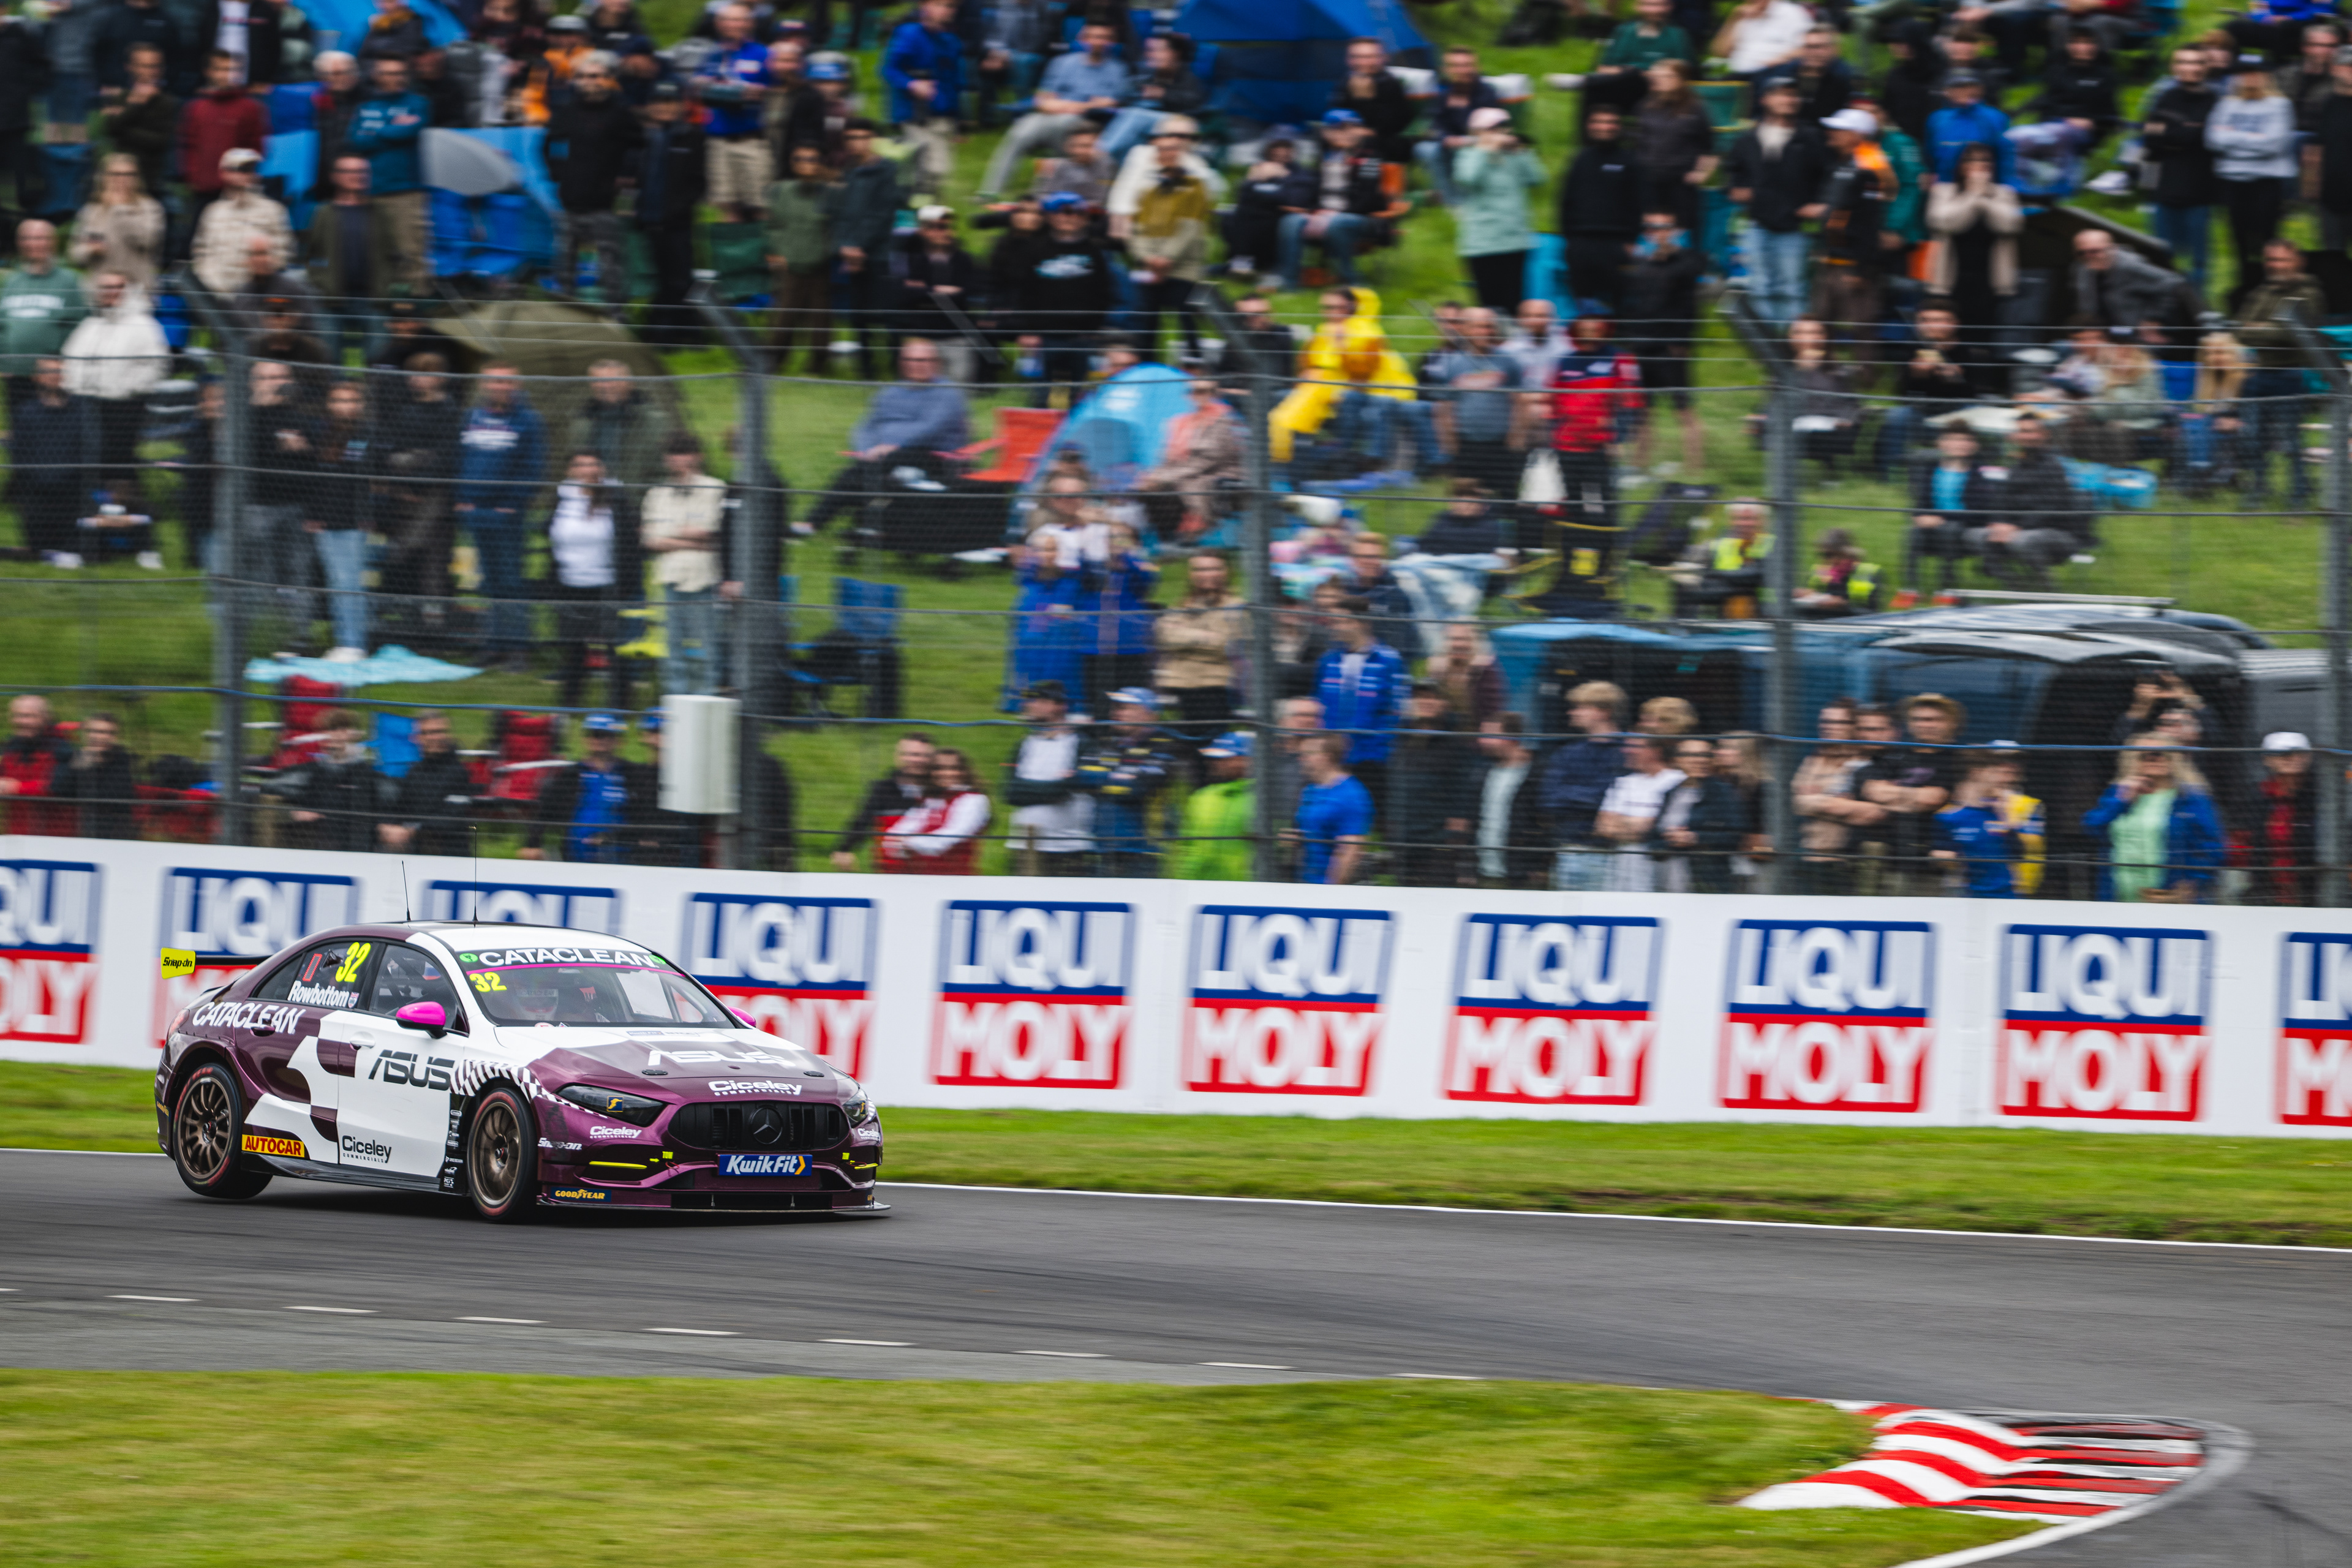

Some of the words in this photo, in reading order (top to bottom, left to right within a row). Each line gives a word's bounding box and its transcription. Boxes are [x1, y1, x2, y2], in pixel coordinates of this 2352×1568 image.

[335, 942, 371, 982] 32
[478, 948, 657, 968] CATACLEAN
[287, 980, 350, 1008] Rowbottom
[469, 972, 507, 992] 32
[192, 1001, 306, 1034] CATACLEAN
[940, 1000, 1131, 1081] MOLY
[1188, 1006, 1384, 1088] MOLY
[368, 1049, 455, 1091] ASUS
[648, 1050, 796, 1067] ASUS
[1453, 1015, 1655, 1098] MOLY
[1726, 1021, 1933, 1104] MOLY
[2003, 1029, 2210, 1112] MOLY
[708, 1080, 802, 1096] Ciceley
[245, 1136, 301, 1156] AUTOCAR
[537, 1137, 582, 1151] Snp-on
[590, 1126, 643, 1139] Ciceley
[342, 1135, 392, 1163] Ciceley
[342, 1153, 385, 1163] COMMERCIALS
[555, 1189, 605, 1200] GOODYEAR
